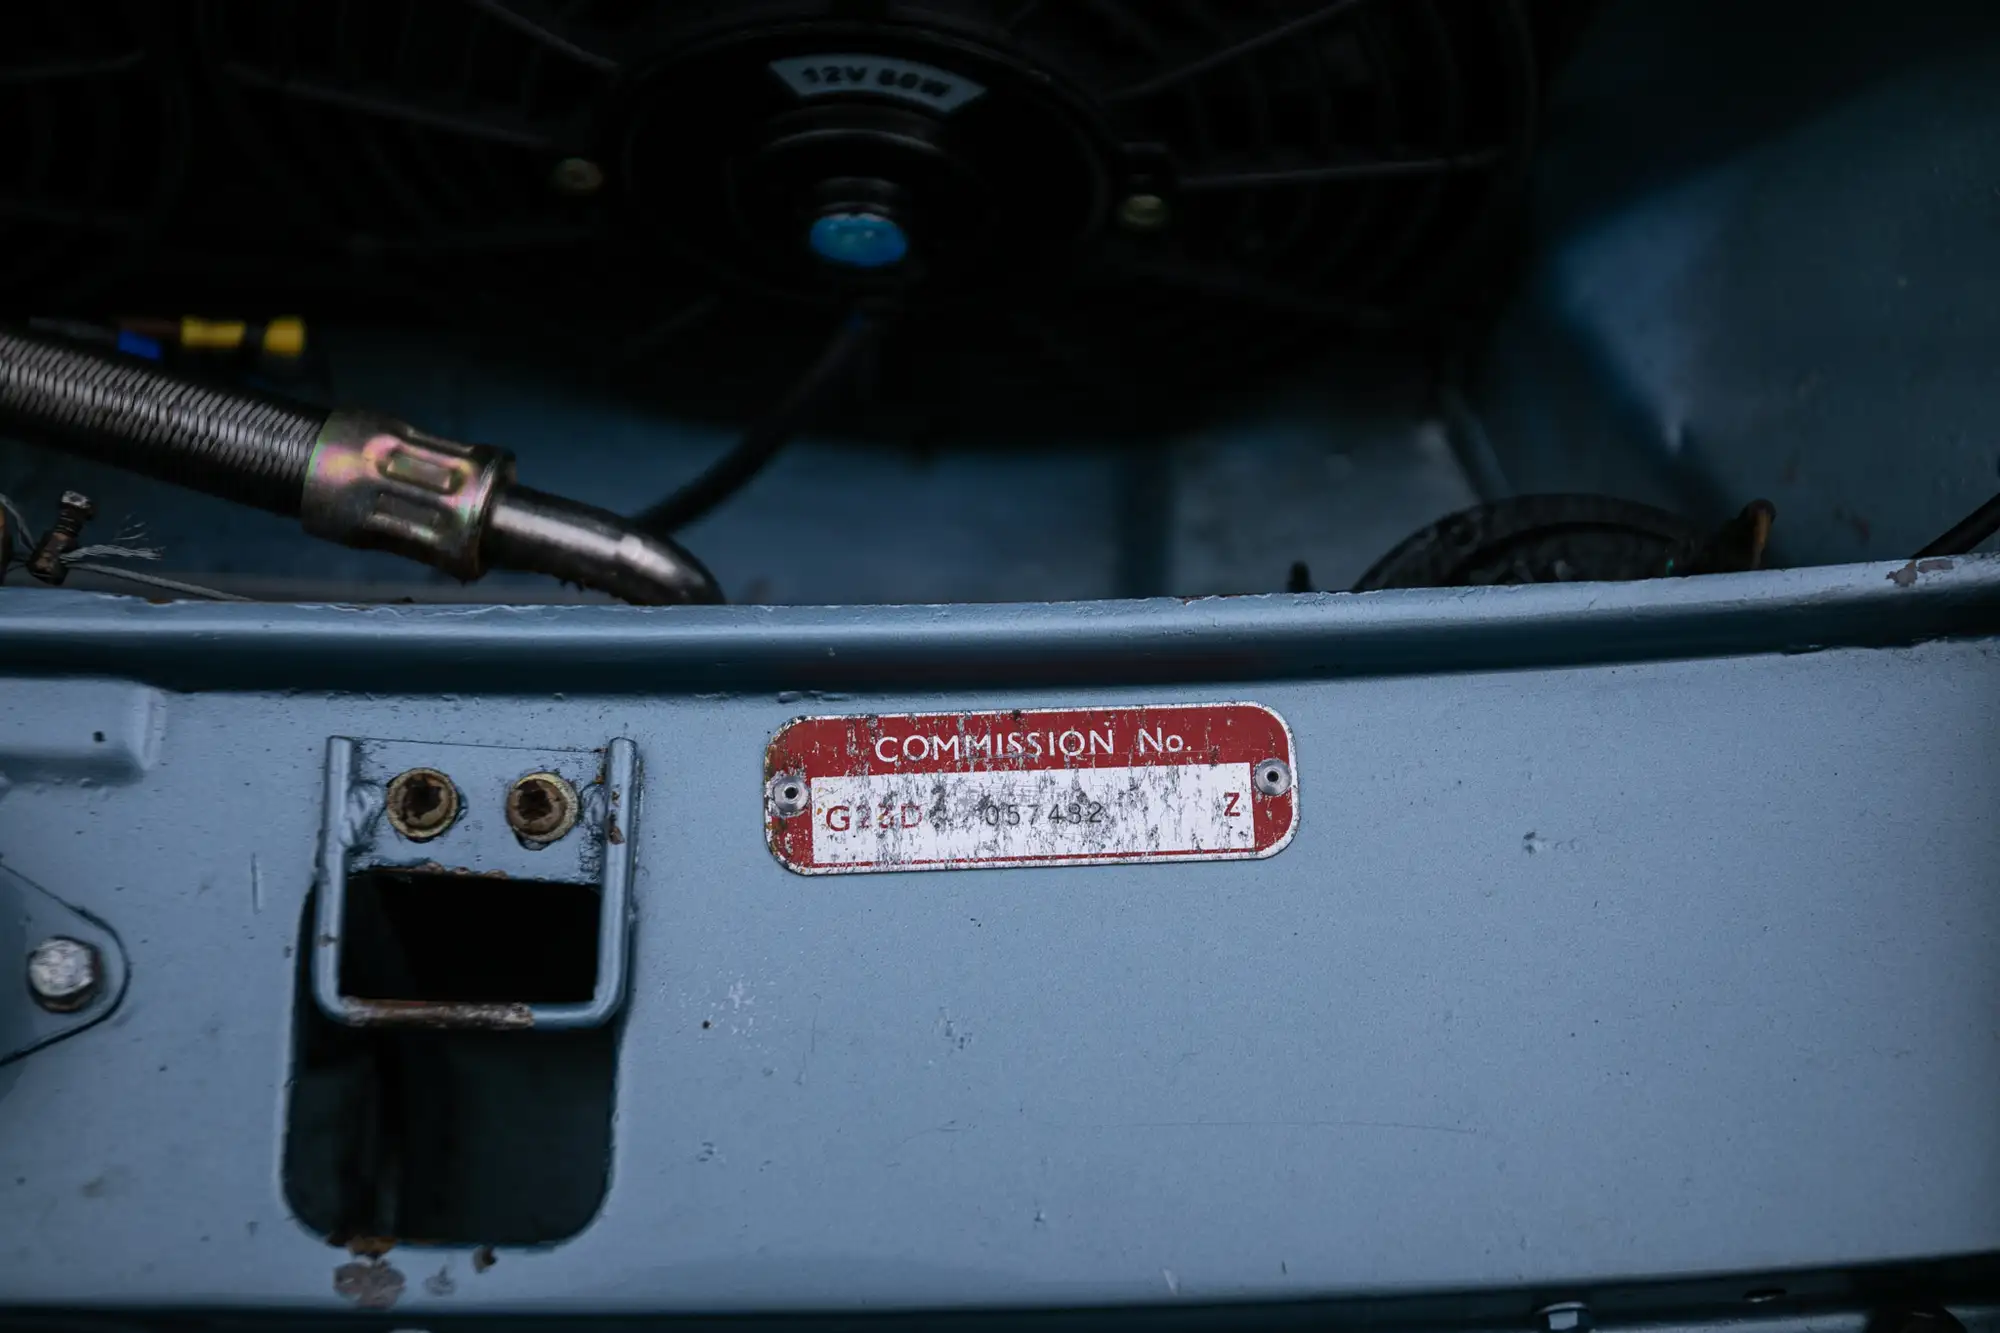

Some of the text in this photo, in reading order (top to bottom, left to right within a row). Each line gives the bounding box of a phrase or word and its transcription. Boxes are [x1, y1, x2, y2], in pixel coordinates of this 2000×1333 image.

[801, 65, 869, 85] 12V
[875, 727, 1192, 762] COMMISSION No.
[1223, 792, 1241, 817] Z
